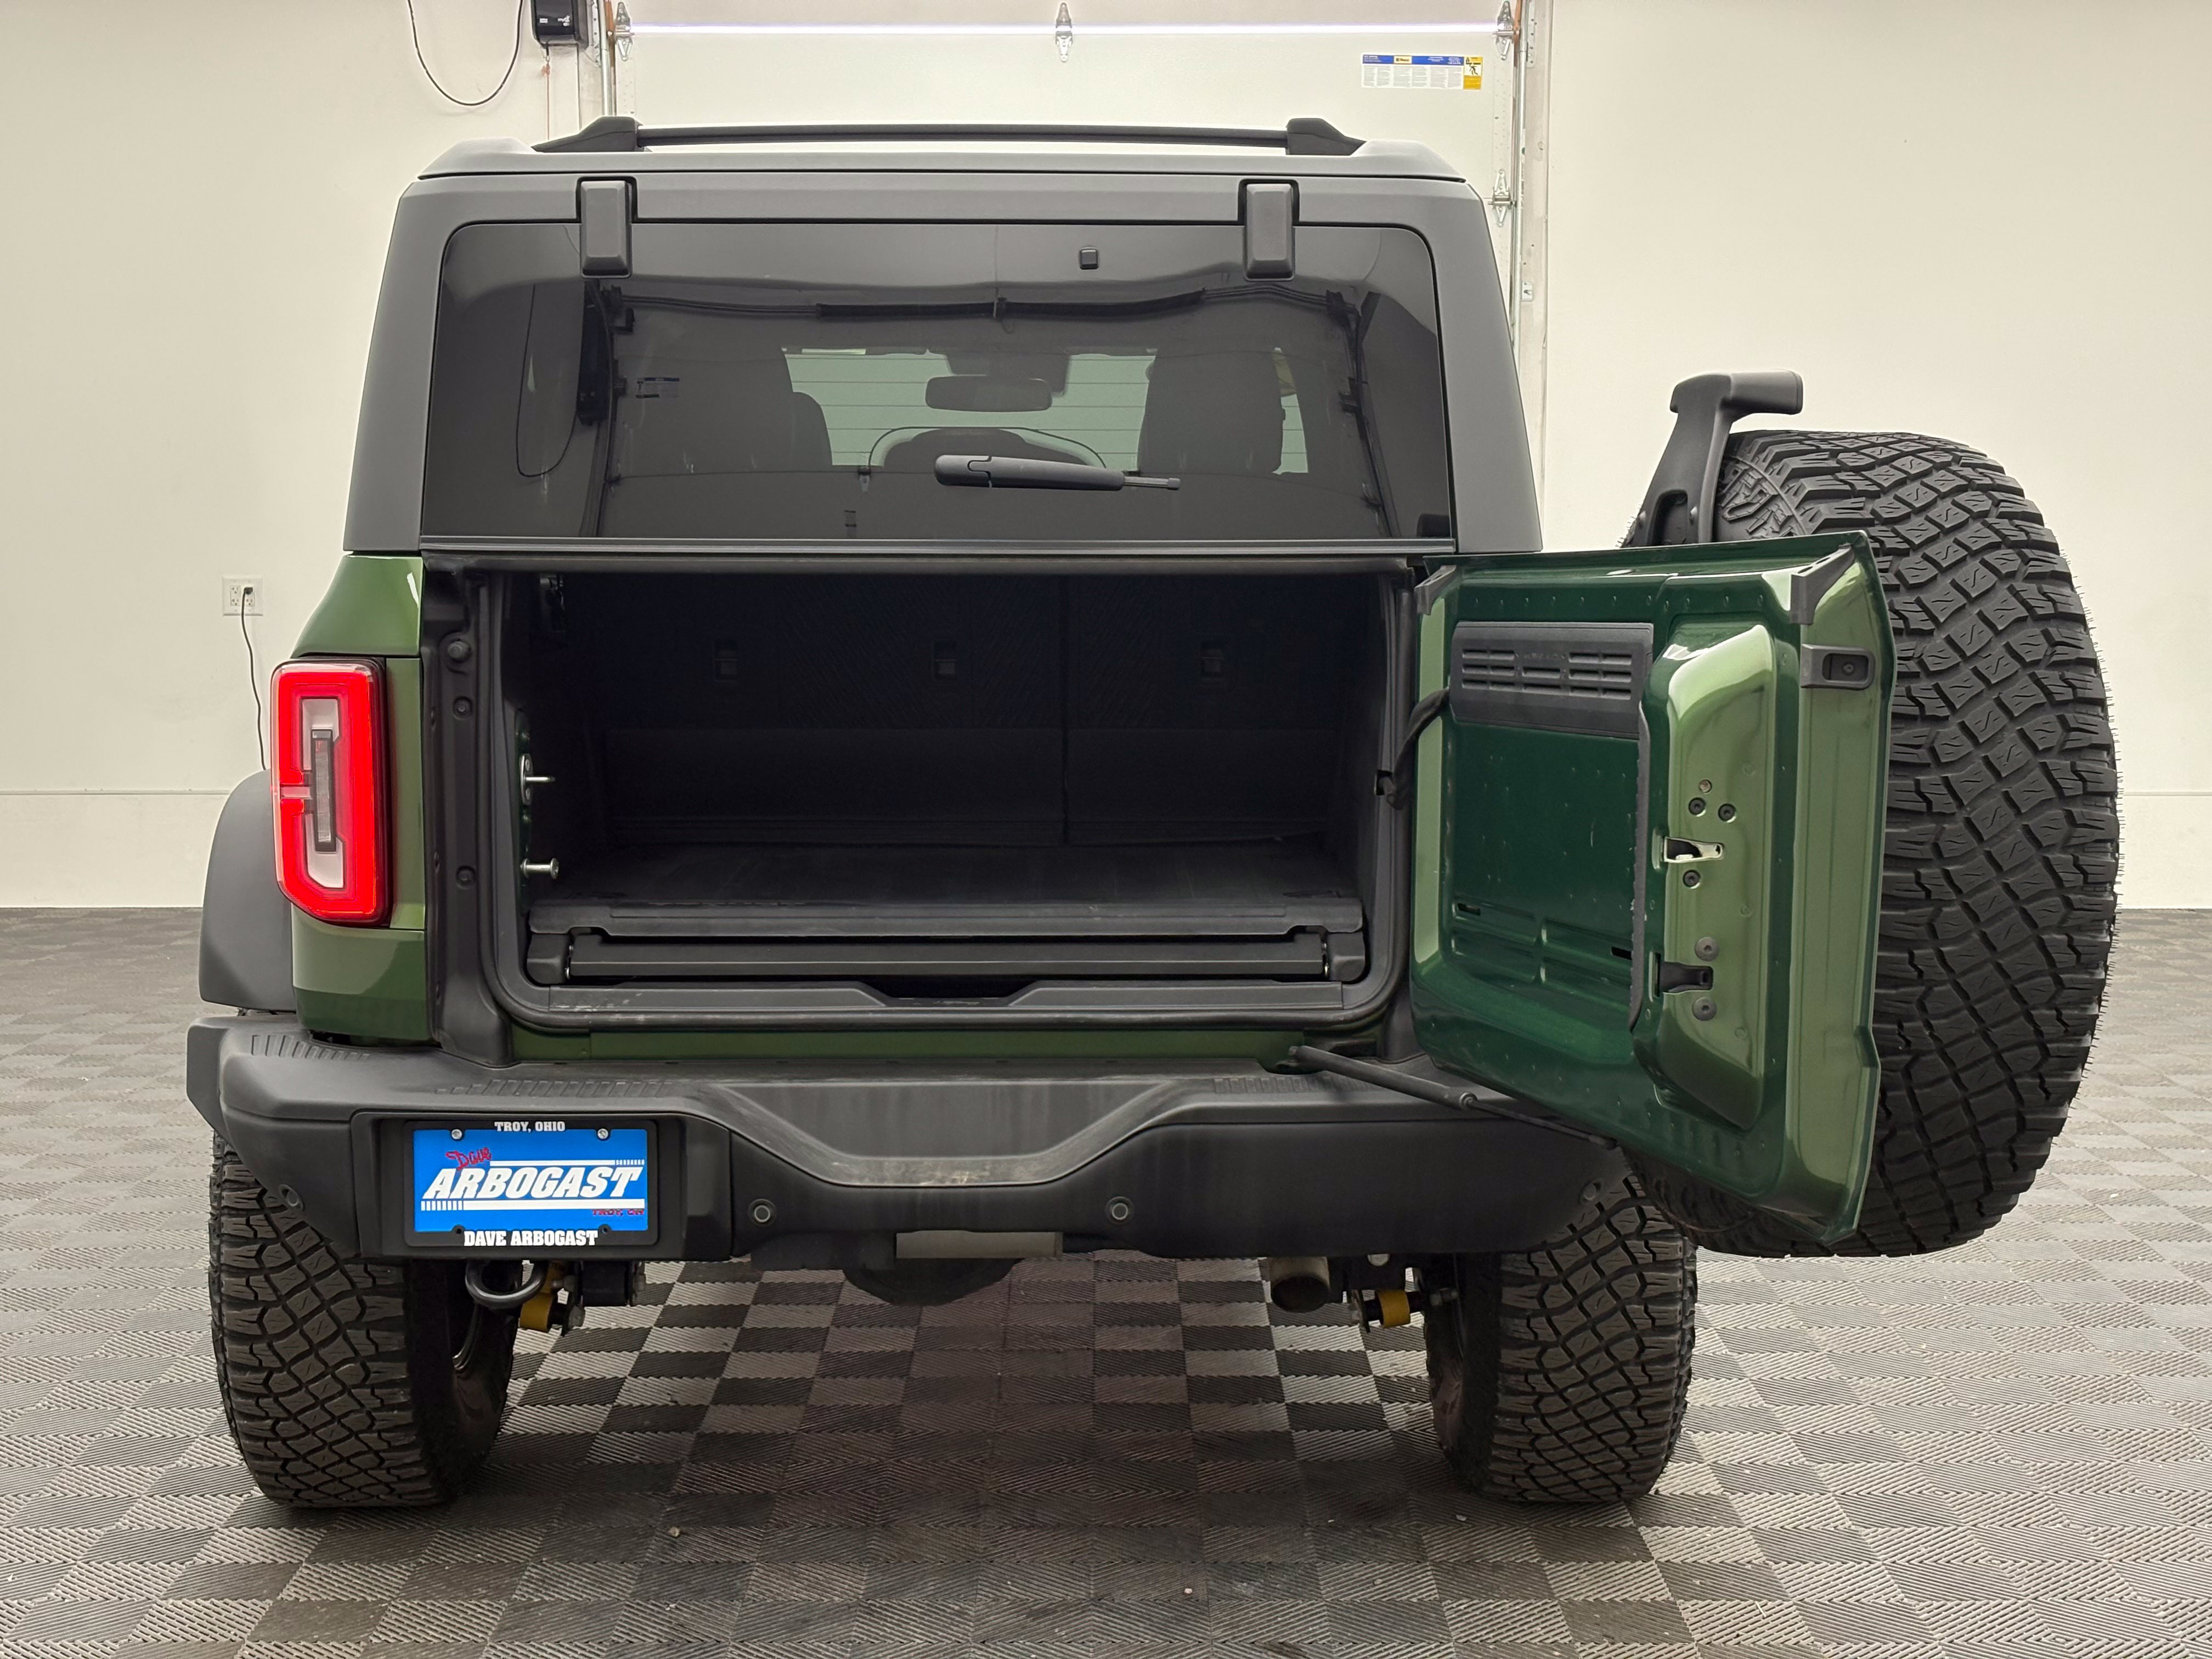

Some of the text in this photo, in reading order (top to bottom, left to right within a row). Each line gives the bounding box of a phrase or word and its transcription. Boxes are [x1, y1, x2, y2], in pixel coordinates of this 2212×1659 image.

[494, 1121, 566, 1133] TROY, OHIO
[445, 1147, 492, 1171] Dave
[422, 1166, 643, 1199] ARBOGAST
[464, 1231, 598, 1246] DAVE ARBOGAST
